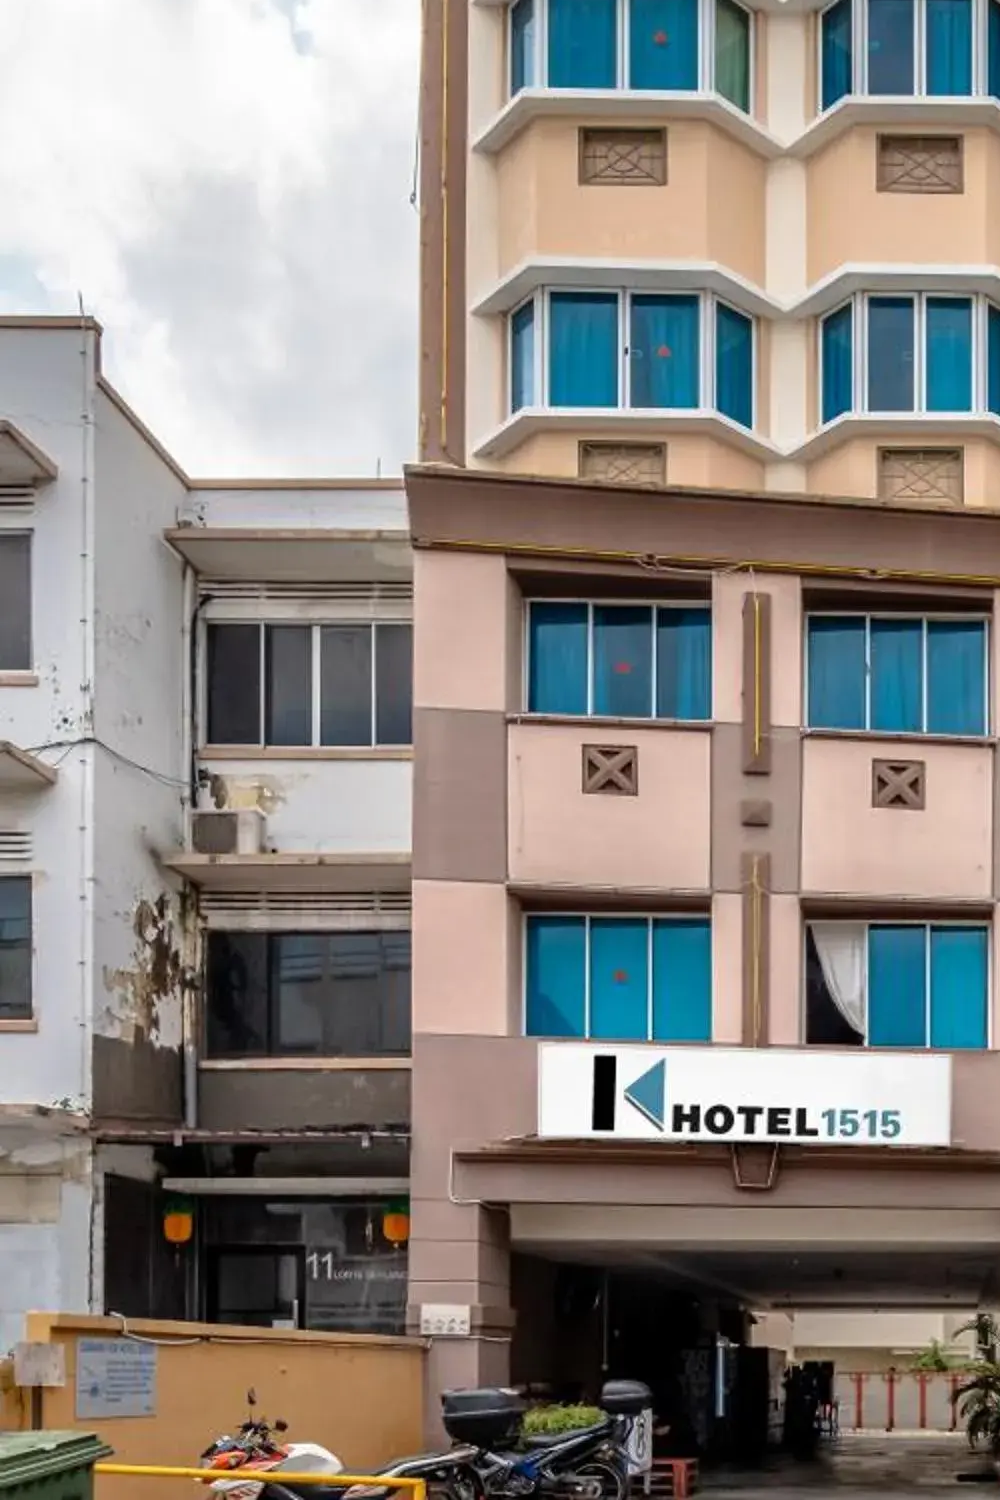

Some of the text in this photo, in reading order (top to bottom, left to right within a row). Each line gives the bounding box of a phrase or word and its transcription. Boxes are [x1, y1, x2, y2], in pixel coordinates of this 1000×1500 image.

[672, 1104, 818, 1136] HOTEL
[821, 1108, 901, 1138] 1515
[306, 1252, 332, 1279] 11
